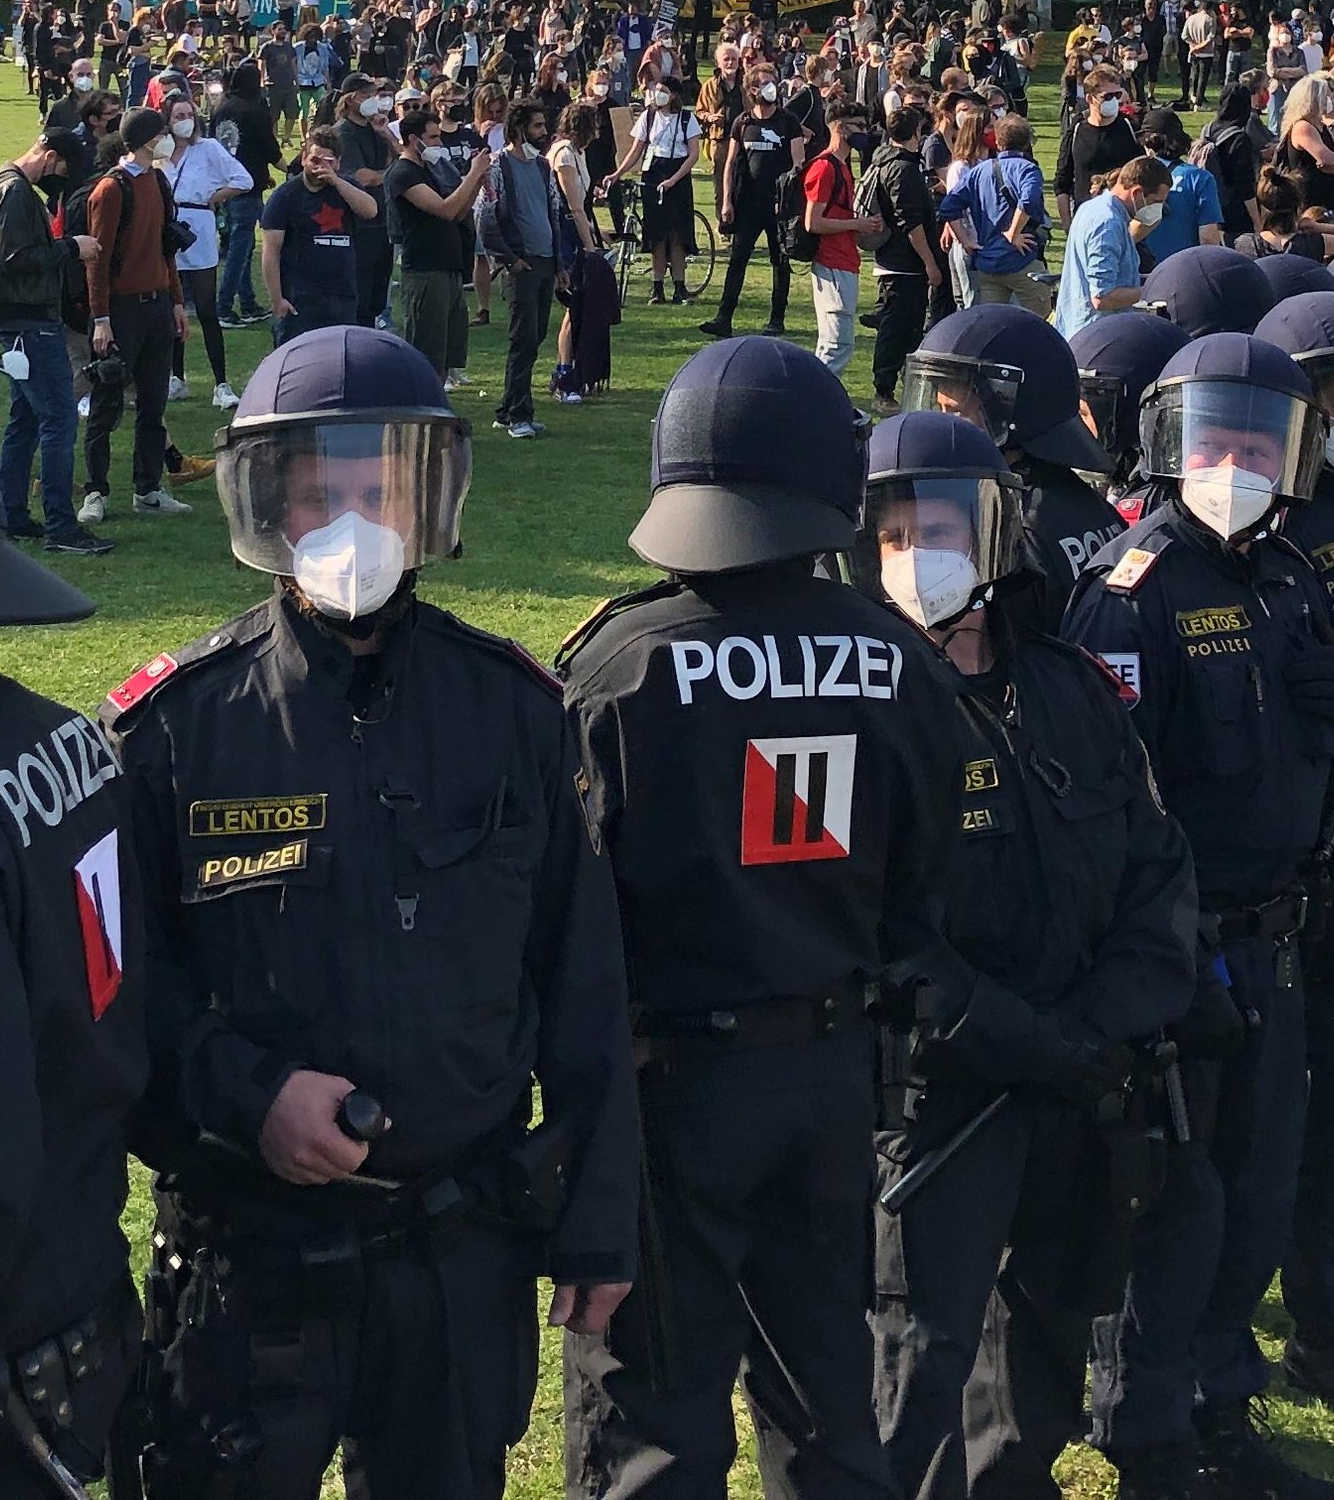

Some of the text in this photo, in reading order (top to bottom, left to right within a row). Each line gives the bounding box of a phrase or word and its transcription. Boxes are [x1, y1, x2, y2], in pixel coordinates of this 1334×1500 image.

[1182, 613, 1240, 635] LENTOS
[1187, 637, 1251, 657] POLIZEI
[670, 635, 903, 704] POLIZEI
[209, 806, 310, 833] LENTOS
